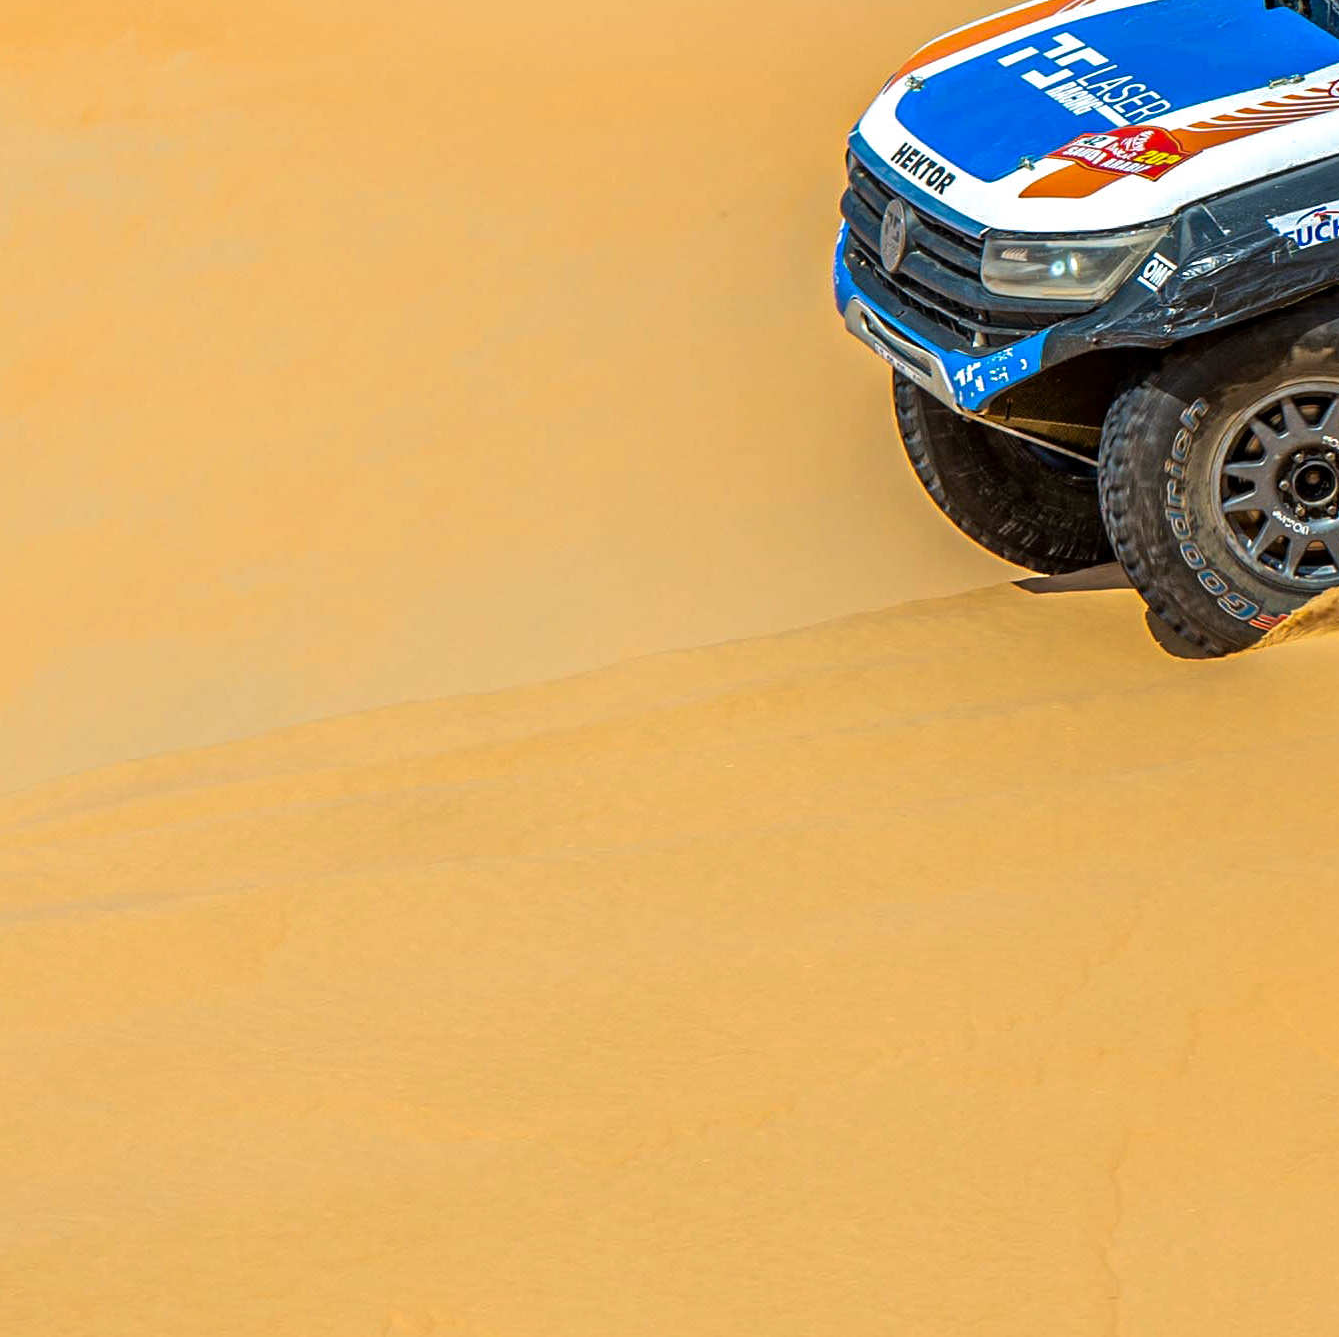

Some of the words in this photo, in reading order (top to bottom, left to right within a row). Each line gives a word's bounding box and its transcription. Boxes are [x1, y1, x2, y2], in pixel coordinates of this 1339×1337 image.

[1044, 80, 1105, 116] RACING
[1076, 65, 1172, 122] LASER
[890, 142, 956, 196] HEKTOR
